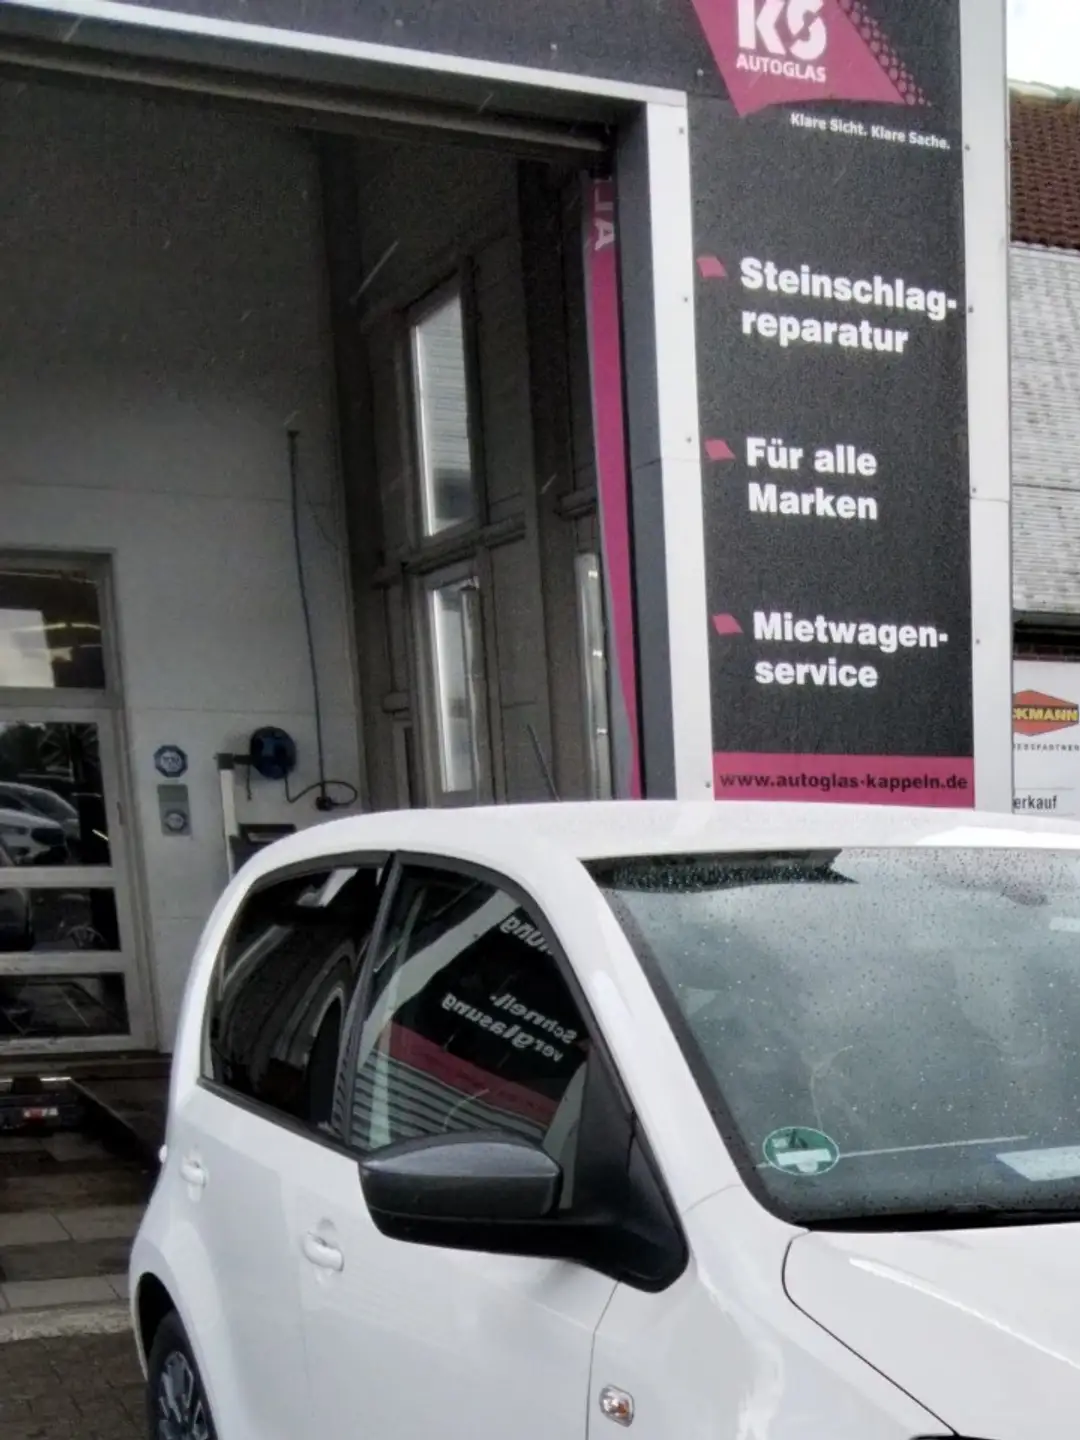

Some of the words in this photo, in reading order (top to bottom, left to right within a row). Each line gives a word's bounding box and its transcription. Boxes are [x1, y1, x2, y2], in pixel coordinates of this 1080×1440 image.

[736, 52, 827, 84] AUTOGLAS
[789, 112, 827, 131] Klare
[829, 116, 868, 137] Sicht.
[871, 124, 906, 143] Klare
[908, 130, 951, 150] Sache.
[740, 256, 958, 322] Steinschlag-
[740, 309, 910, 353] reparatur
[746, 436, 803, 471] Für
[813, 443, 878, 476] alle
[748, 482, 879, 520] Marken
[753, 610, 949, 653] Mietwagen-
[754, 657, 879, 689] service
[719, 773, 969, 791] www.autoglas-kappeln.de
[1012, 795, 1058, 810] erkauf
